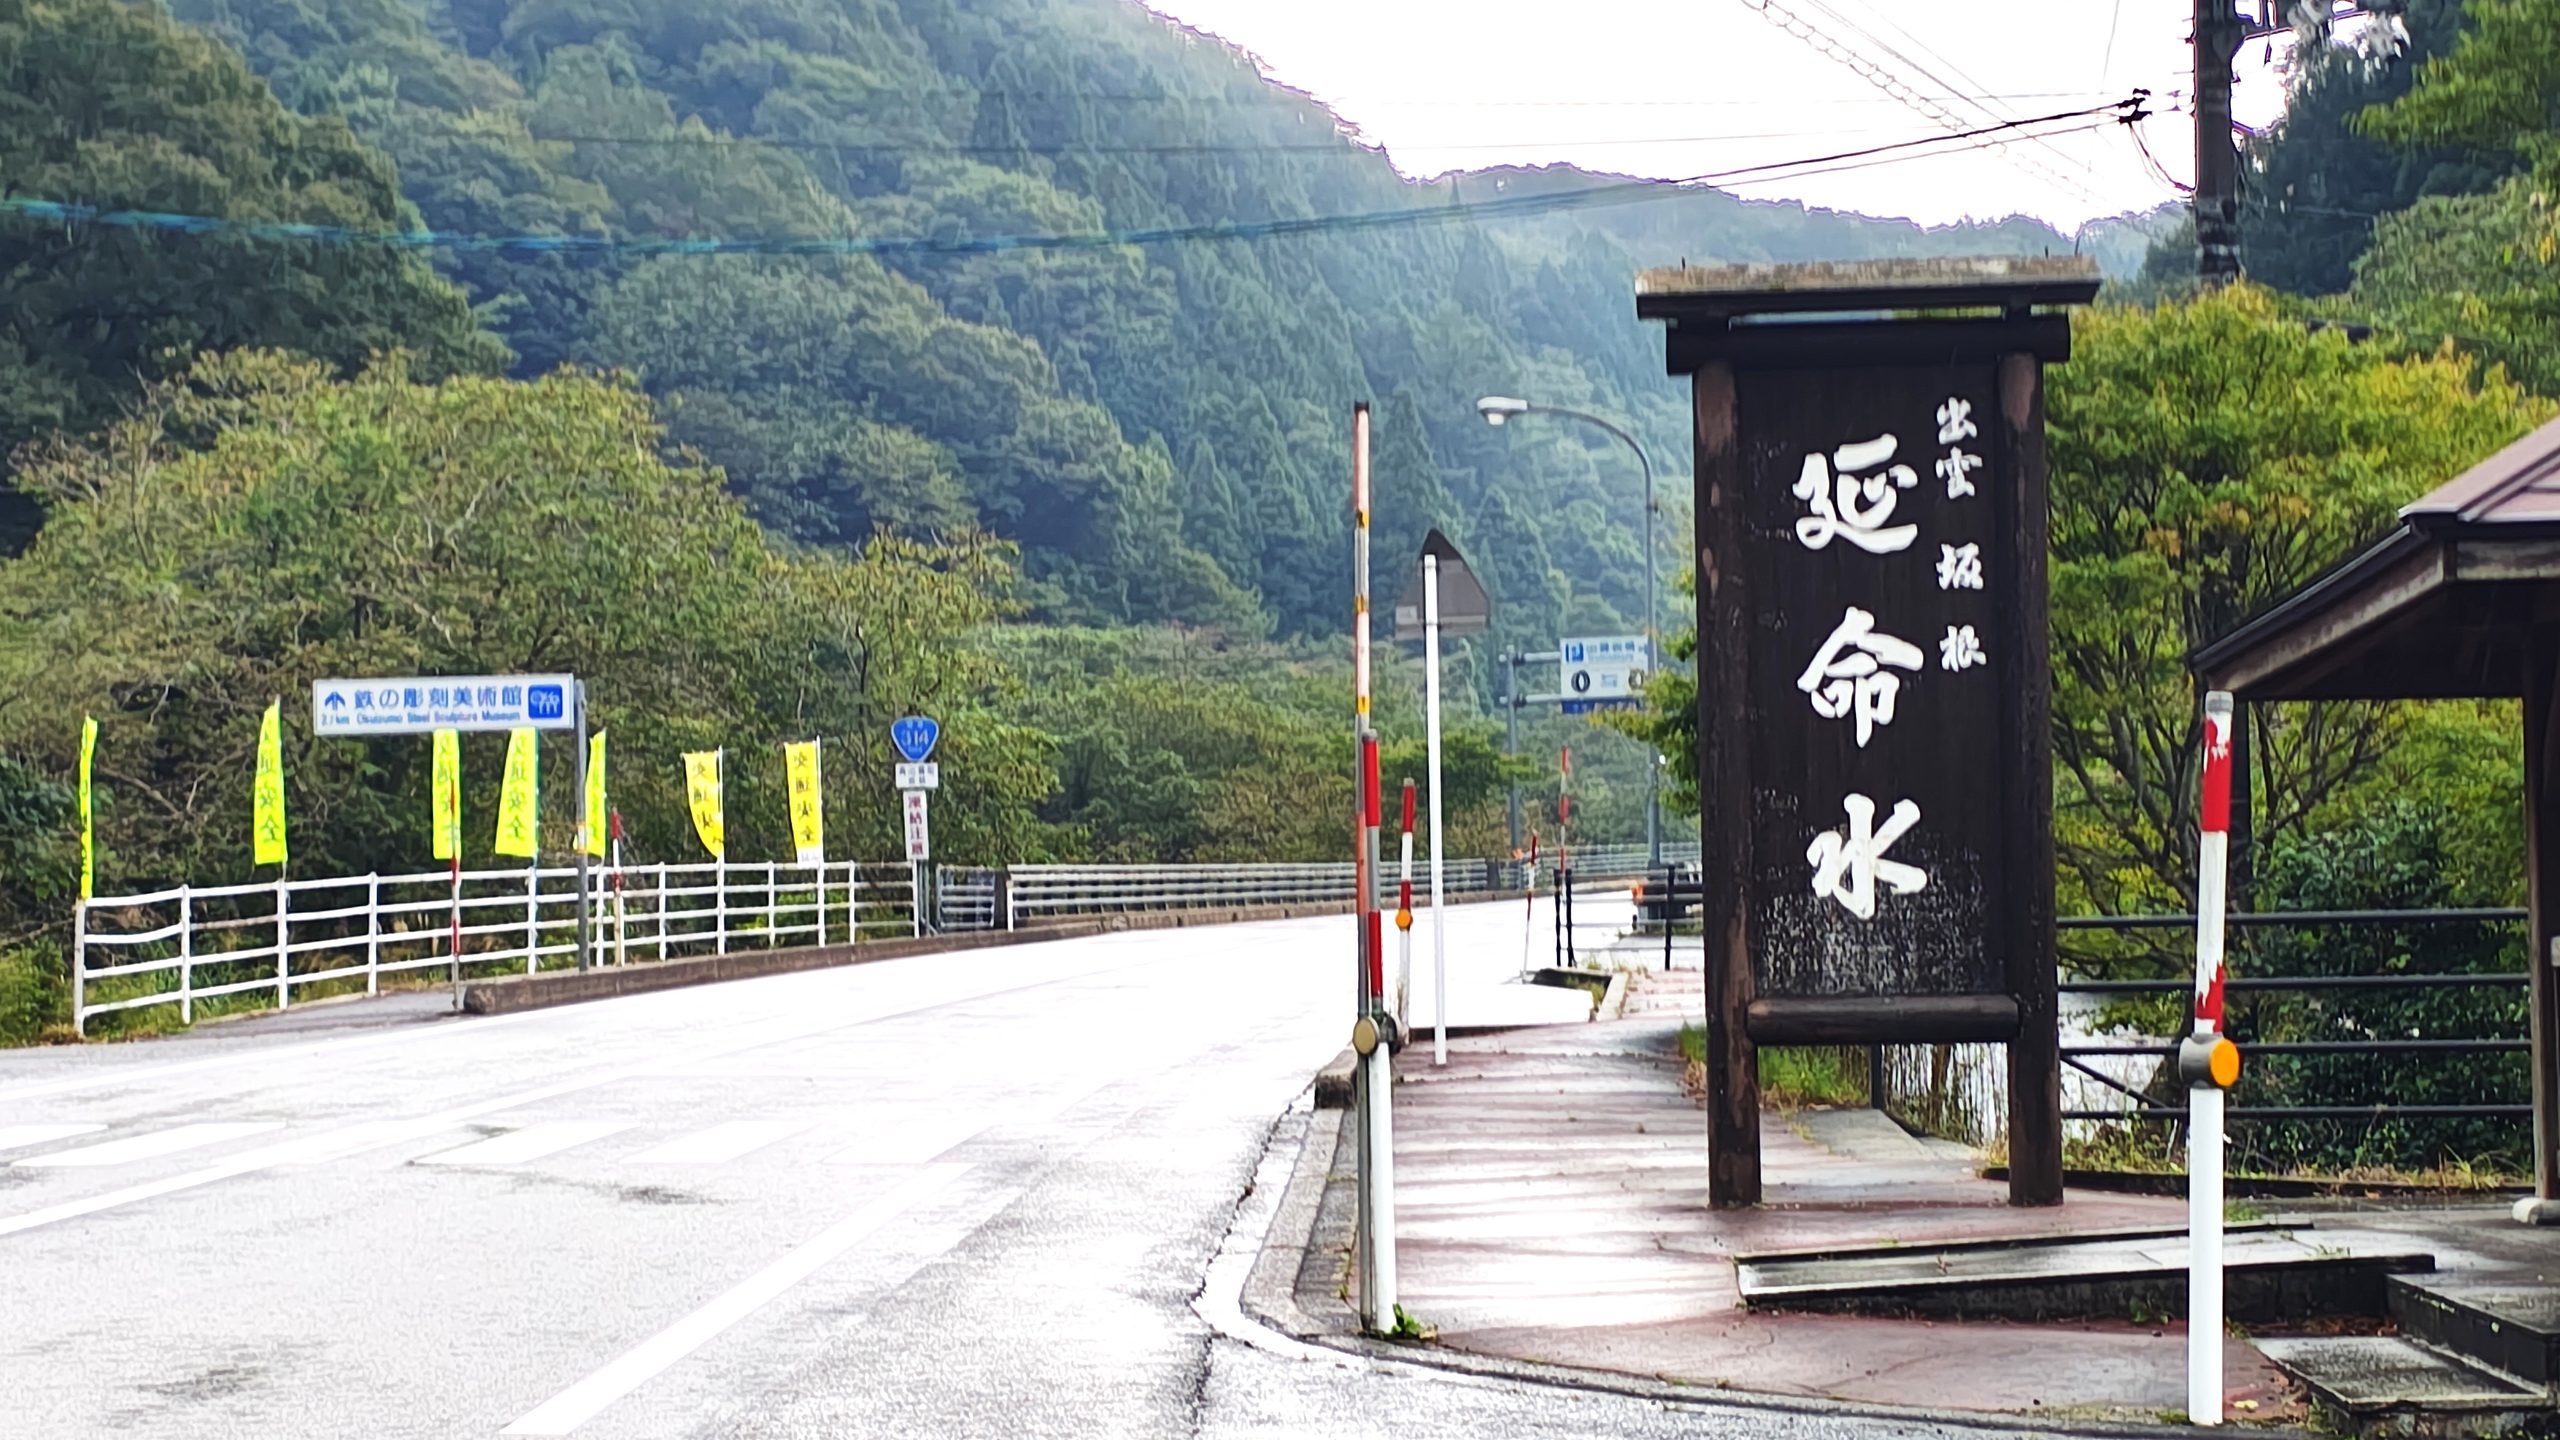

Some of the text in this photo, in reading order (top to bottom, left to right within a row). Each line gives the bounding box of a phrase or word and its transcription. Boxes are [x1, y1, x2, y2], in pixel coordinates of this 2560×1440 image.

[1792, 433, 1928, 921] 延命水
[354, 685, 522, 710] 鉄の彫刻美術館
[901, 729, 929, 746] 314
